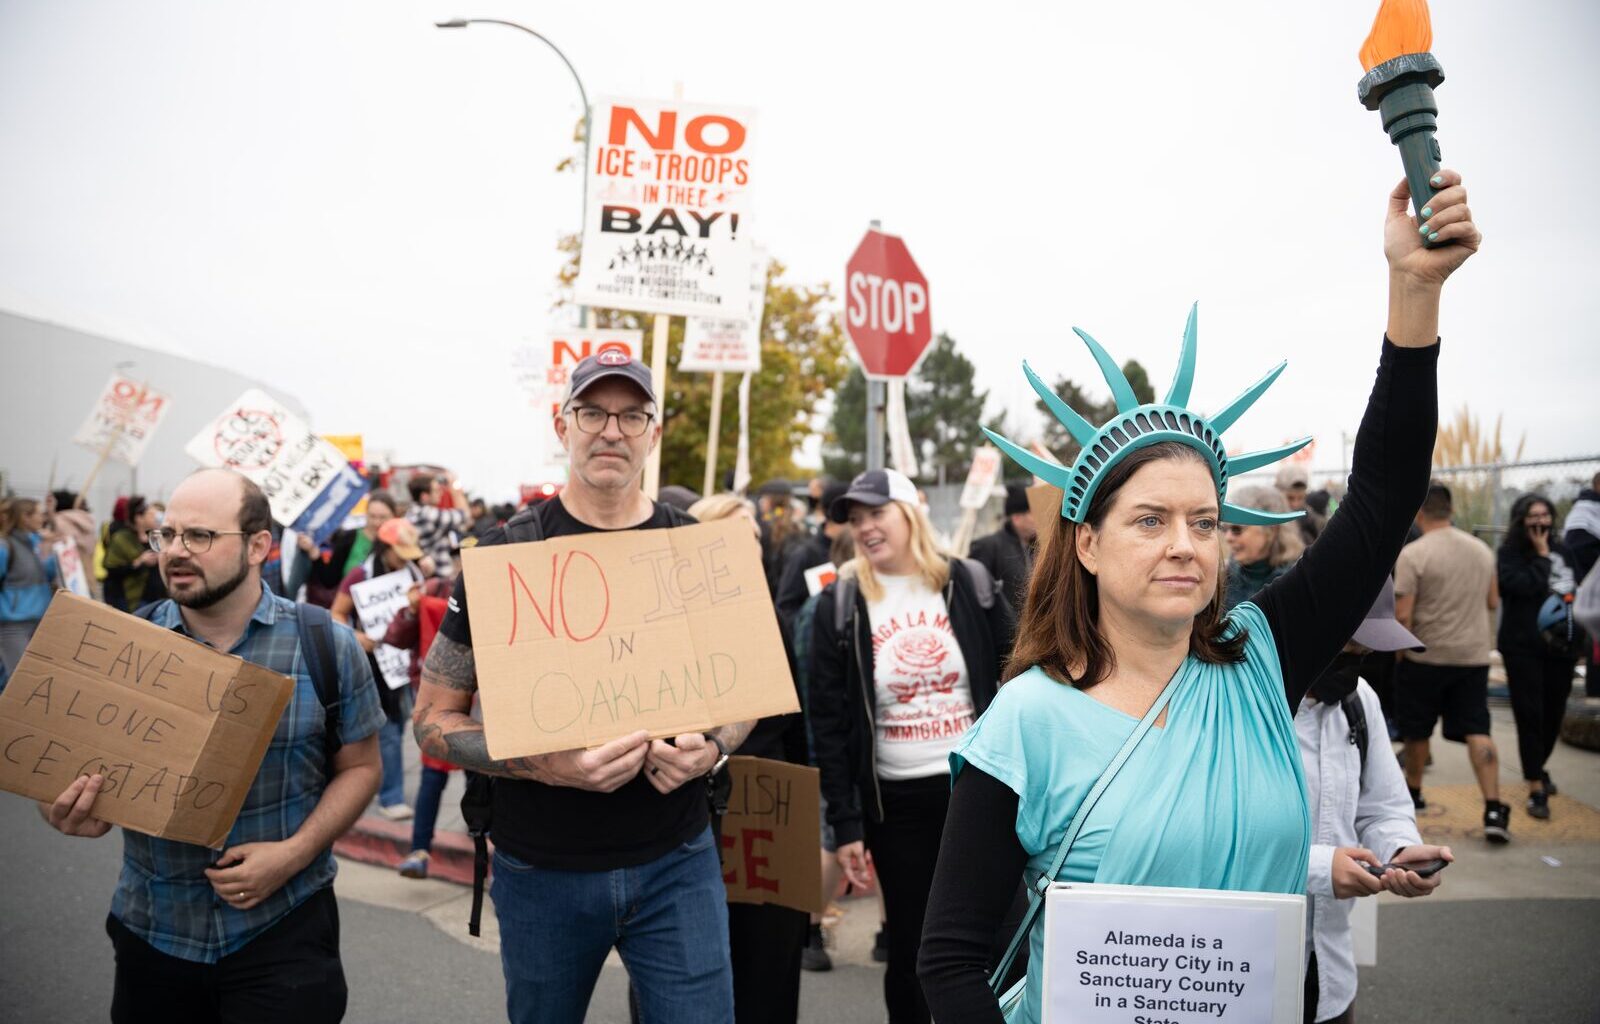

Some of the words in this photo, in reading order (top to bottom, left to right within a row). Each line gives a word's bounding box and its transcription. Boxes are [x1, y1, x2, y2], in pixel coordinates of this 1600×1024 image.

[608, 106, 746, 154] NO
[596, 147, 636, 177] ICE
[654, 153, 749, 185] TROOPS
[643, 184, 658, 204] IN
[601, 204, 739, 240] BAY!
[849, 271, 927, 335] STOP
[507, 551, 610, 646] NO
[630, 537, 741, 624] ICE
[906, 611, 926, 627] LA
[608, 632, 635, 663] IN
[24, 677, 177, 742] ALONE
[206, 671, 257, 714] US
[531, 653, 737, 733] OAKLAND
[1104, 931, 1185, 948] Alameda
[1191, 934, 1206, 949] is
[1212, 938, 1223, 949] a
[1076, 950, 1169, 972] Sanctuary
[1175, 955, 1211, 974] City
[1217, 957, 1234, 972] in
[1240, 961, 1250, 973] a
[1079, 971, 1172, 993] Sanctuary
[1178, 976, 1245, 997] County
[1095, 993, 1111, 1007] in
[1117, 997, 1128, 1008] a
[1133, 994, 1227, 1017] Sanctuary
